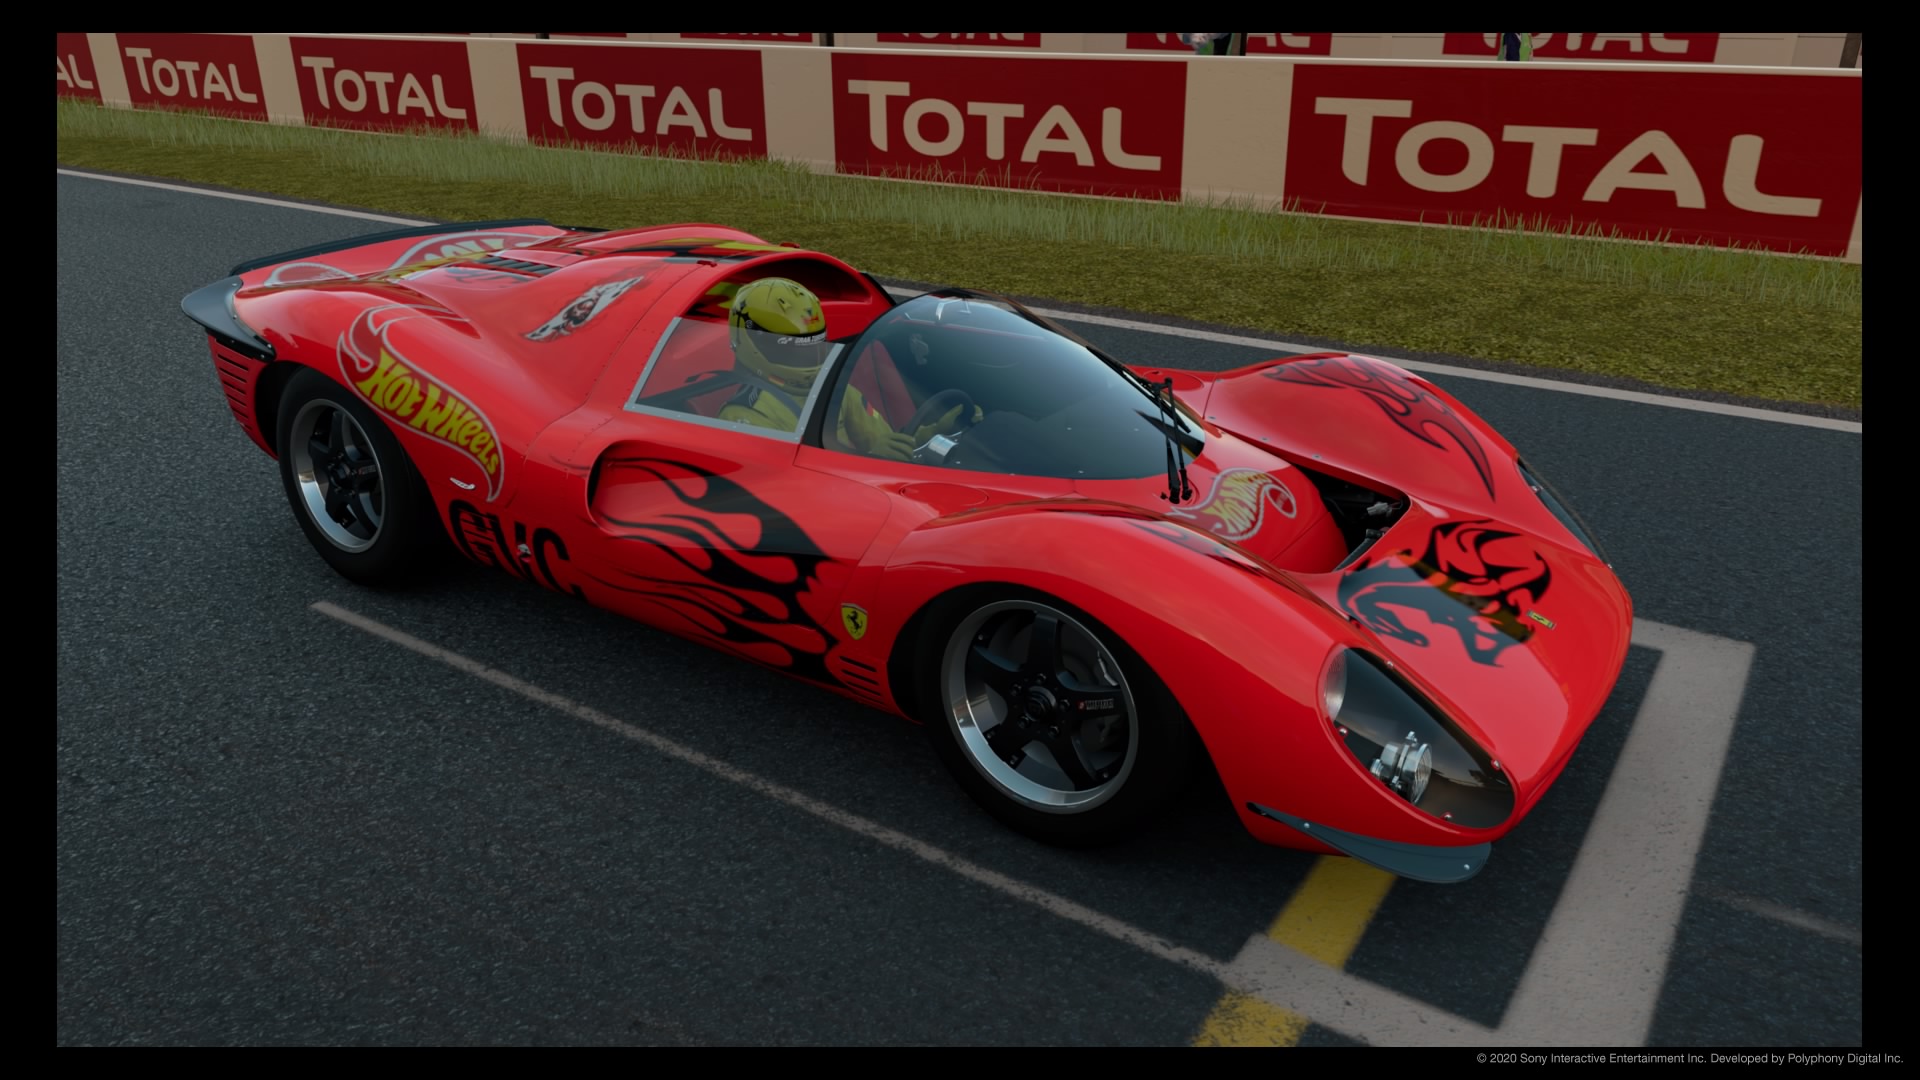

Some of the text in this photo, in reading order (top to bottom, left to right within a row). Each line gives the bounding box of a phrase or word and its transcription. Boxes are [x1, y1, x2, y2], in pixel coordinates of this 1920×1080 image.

[125, 47, 258, 103] TOTAL
[301, 56, 467, 119] TOTAL
[529, 65, 752, 141] TOTAL
[847, 79, 1161, 171] TOTAL
[1314, 96, 1823, 217] TOTAL
